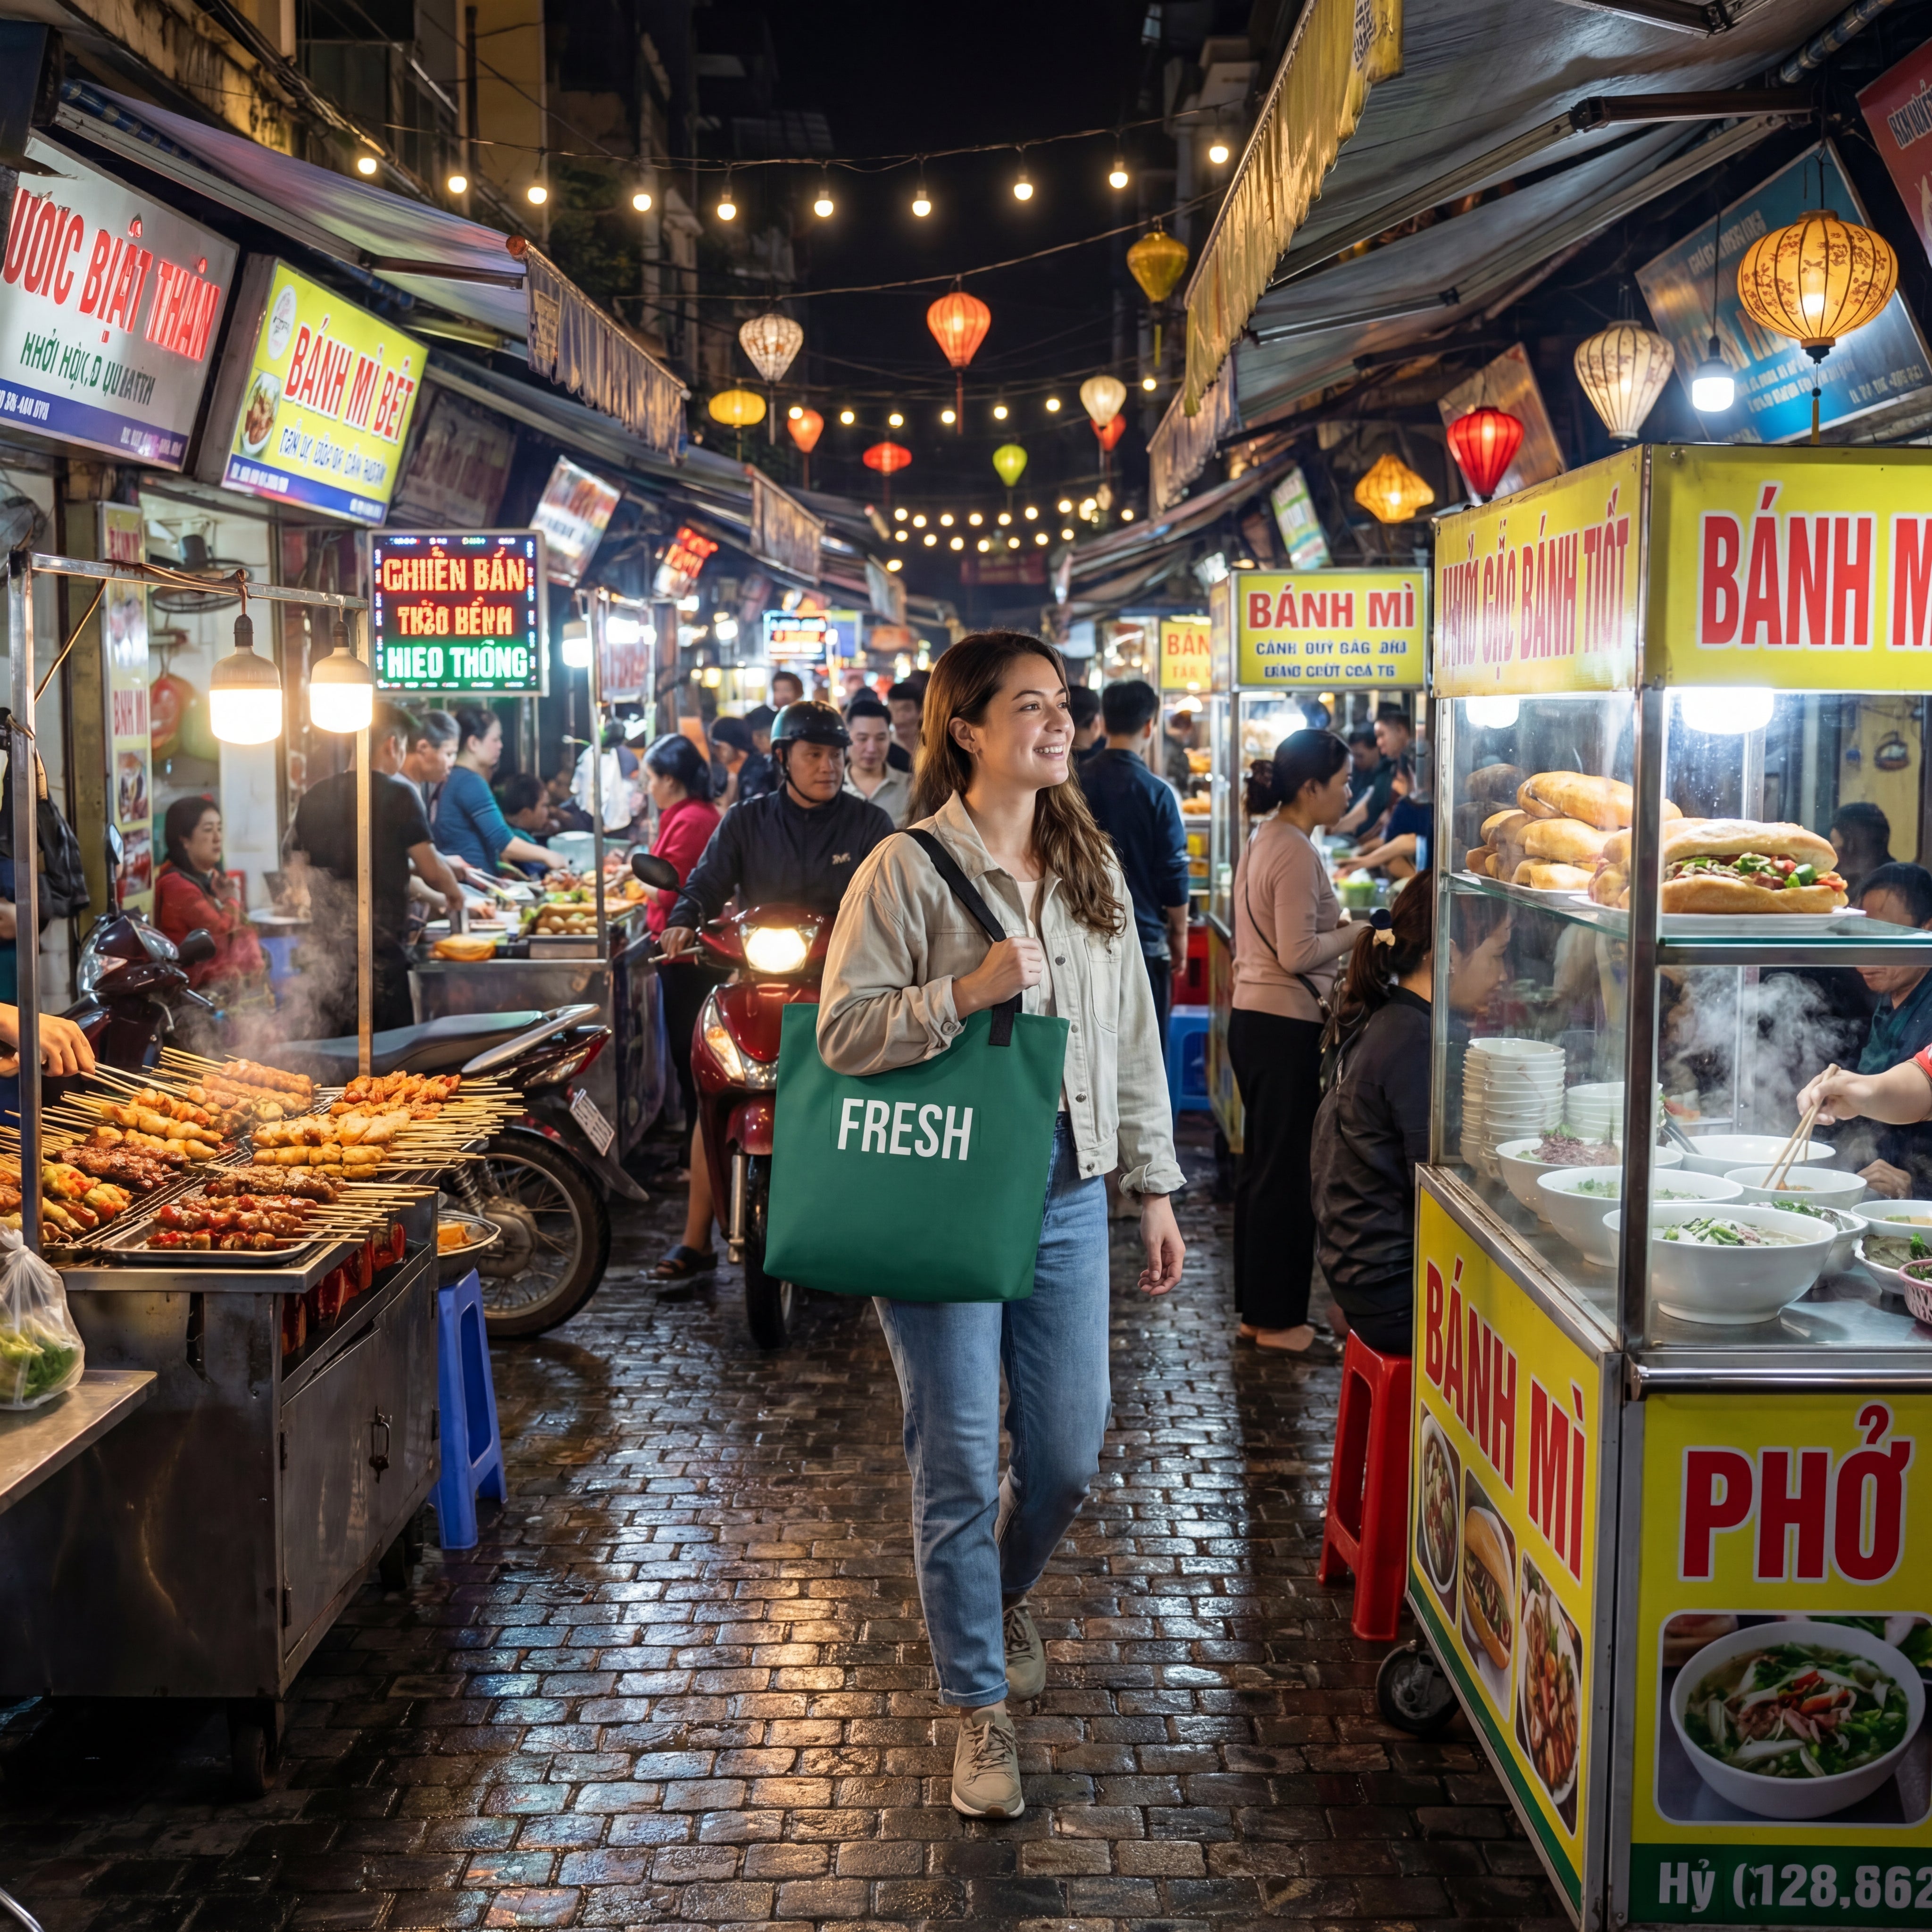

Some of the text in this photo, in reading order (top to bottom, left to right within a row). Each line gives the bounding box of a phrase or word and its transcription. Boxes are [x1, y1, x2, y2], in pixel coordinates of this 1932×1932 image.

[284, 317, 353, 416] BÁNH
[1249, 584, 1353, 628] BÁNH
[1368, 583, 1414, 627] MÌ
[1520, 515, 1578, 660] BÁNH
[1701, 486, 1872, 645] BÁNH
[837, 1098, 974, 1161] FRESH
[1425, 1257, 1585, 1584] BÁNH MÌ
[1683, 1404, 1911, 1581] PHỞ
